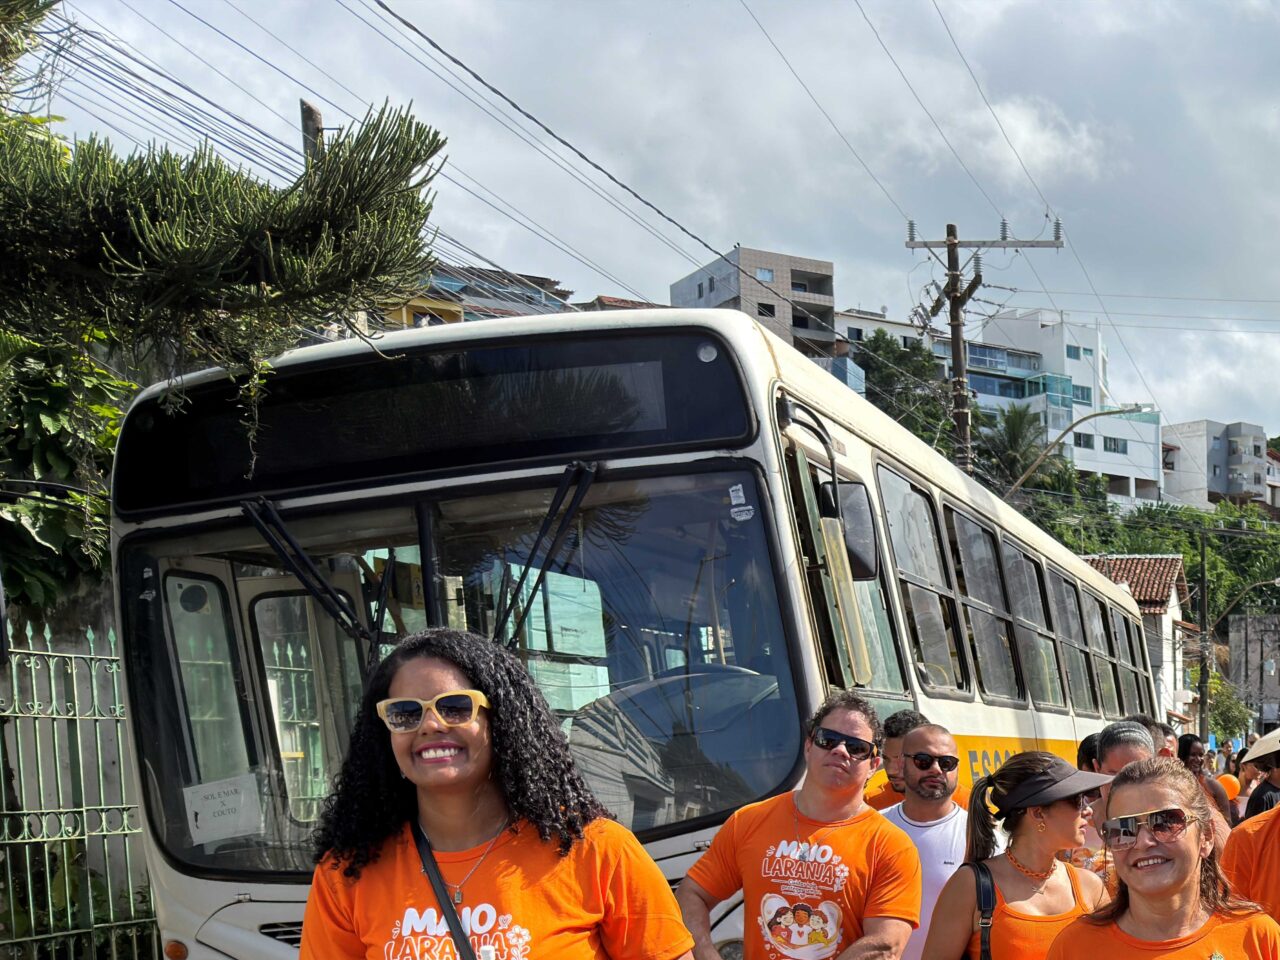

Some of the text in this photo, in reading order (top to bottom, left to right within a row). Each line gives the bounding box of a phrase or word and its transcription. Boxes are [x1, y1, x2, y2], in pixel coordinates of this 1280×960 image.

[213, 808, 237, 818] COUTO
[775, 840, 833, 863] MAIO
[762, 858, 834, 885] LARANJA
